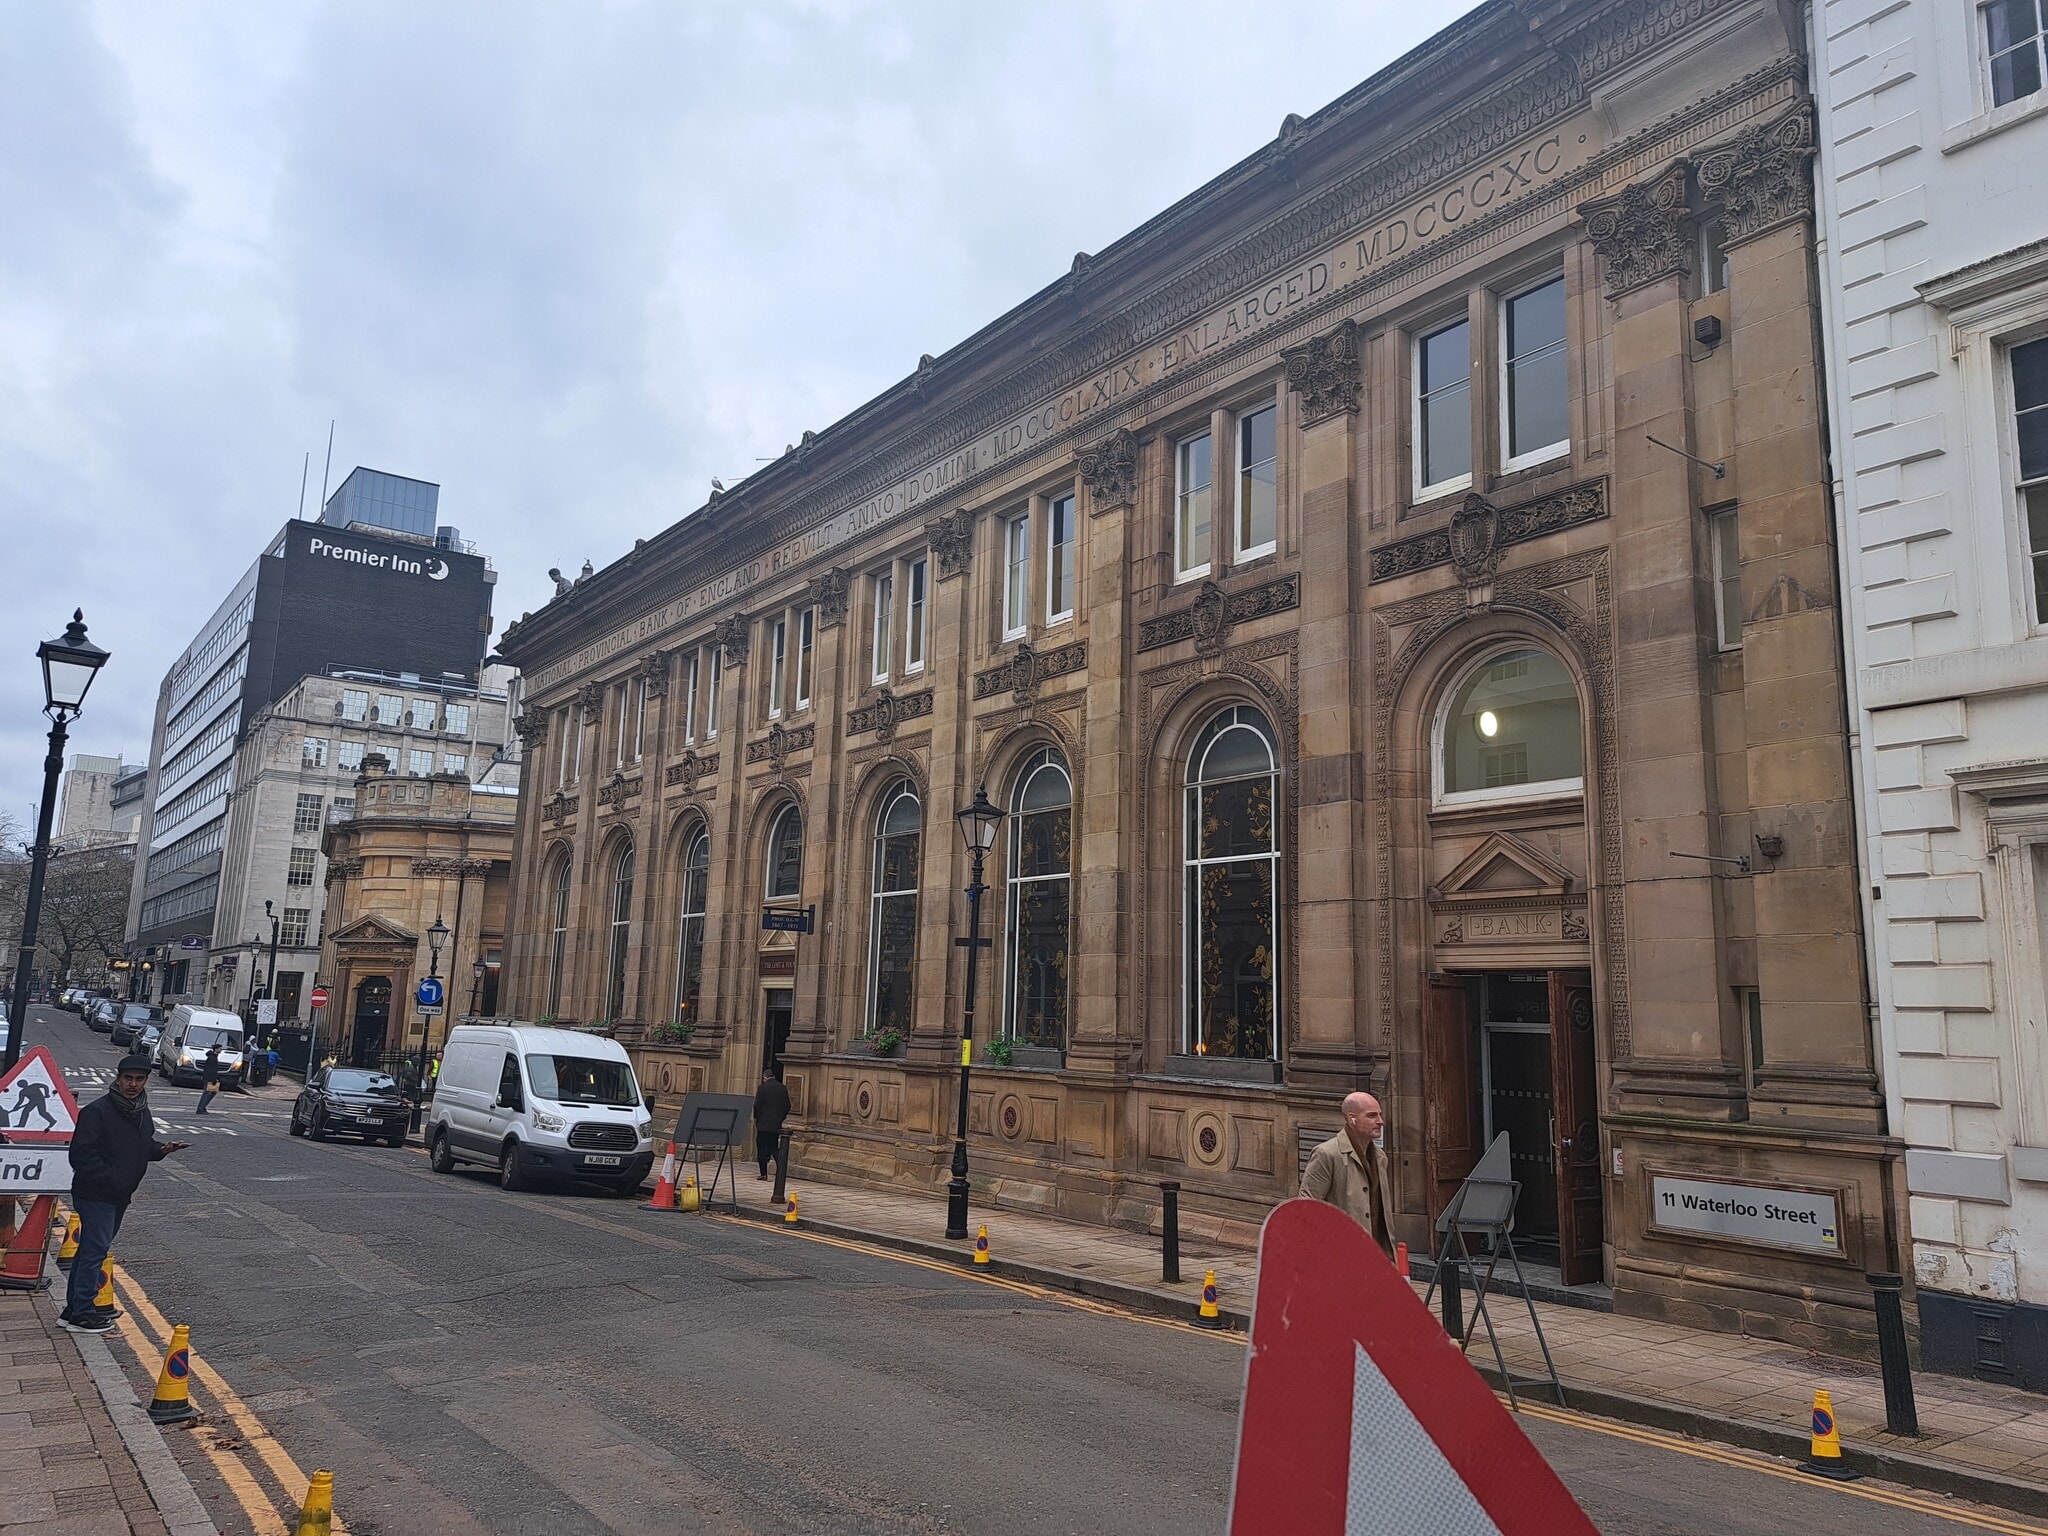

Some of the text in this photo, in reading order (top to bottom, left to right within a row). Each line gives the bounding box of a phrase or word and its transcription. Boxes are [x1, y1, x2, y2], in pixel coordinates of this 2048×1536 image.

[534, 660, 572, 690] NATIONAL
[577, 629, 632, 668] PROVINCIAL
[640, 609, 668, 638] BANK
[677, 599, 691, 618] OF
[700, 562, 761, 607] ENGLAND
[846, 493, 894, 535] ANNO
[909, 447, 977, 503] DOMINI
[993, 359, 1141, 459] MDCCCLXIX
[1162, 262, 1328, 371] ENLARGED
[1356, 134, 1561, 271] MDCCCXC
[309, 538, 421, 575] Premier Inn
[1480, 914, 1547, 936] BANK
[0, 1157, 44, 1181] nd
[1661, 1192, 1817, 1225] 11 Waterloo Street
